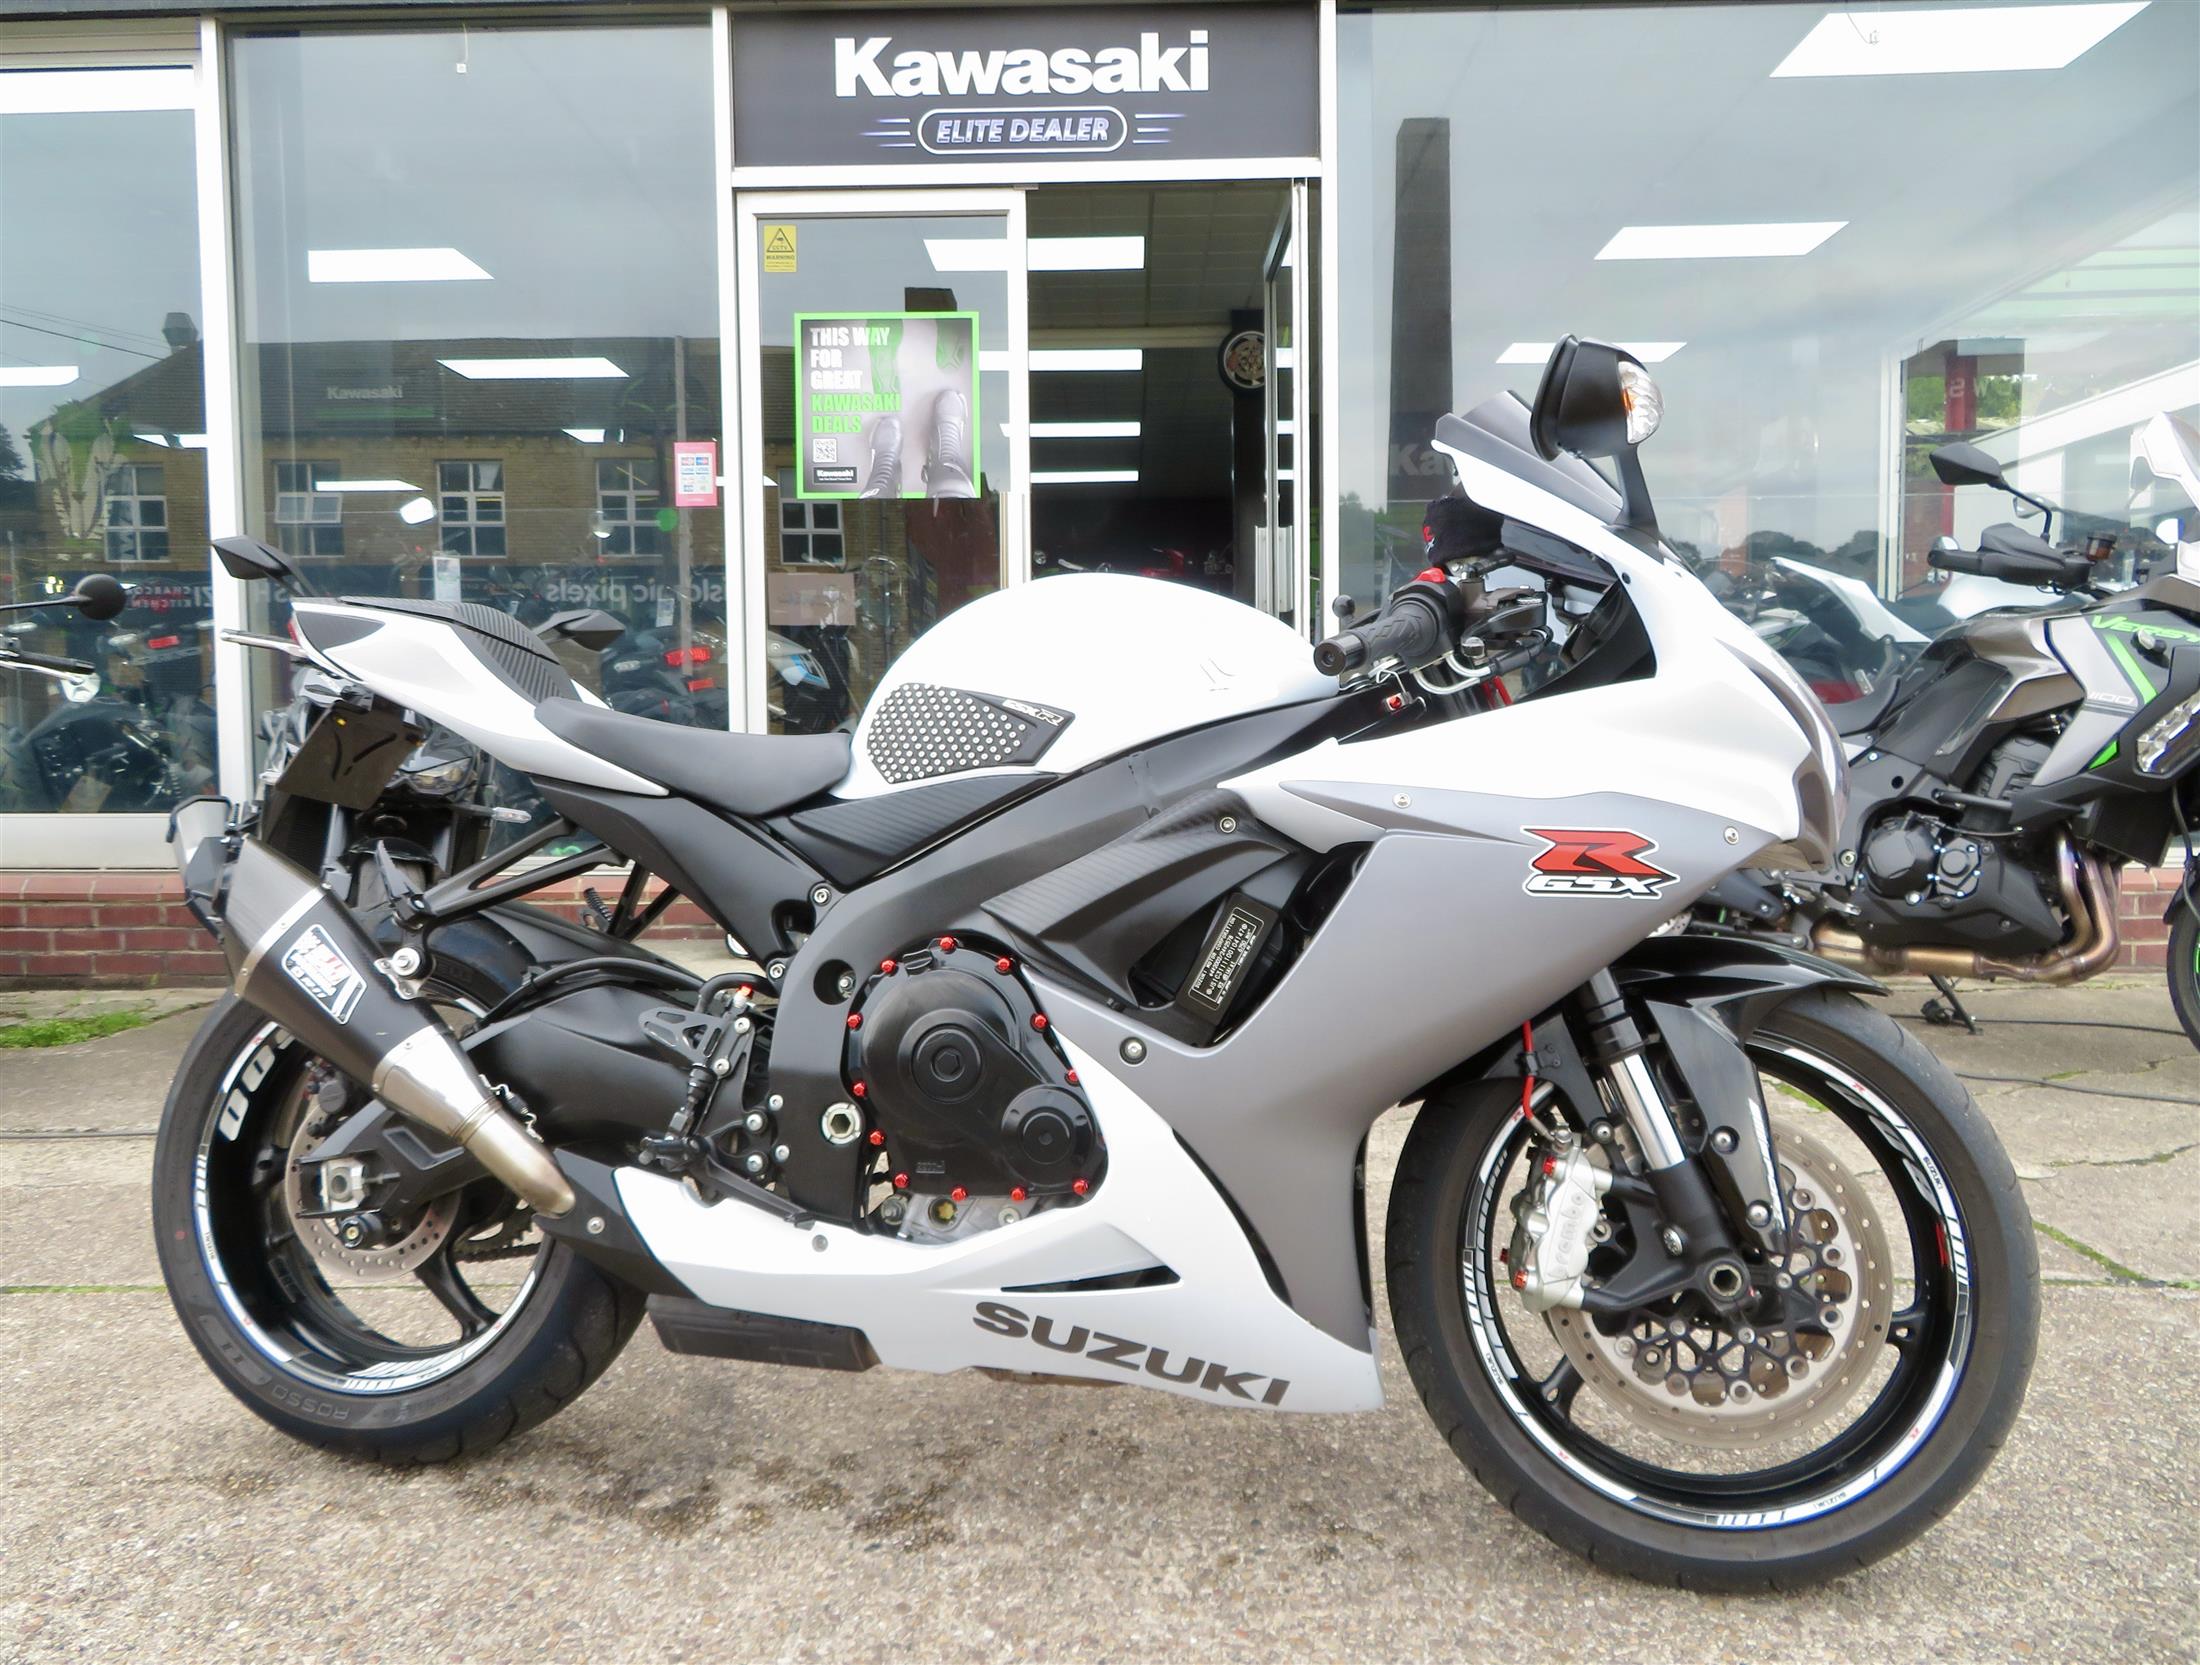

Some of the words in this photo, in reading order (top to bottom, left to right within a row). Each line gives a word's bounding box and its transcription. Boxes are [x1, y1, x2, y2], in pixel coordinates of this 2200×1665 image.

[835, 30, 1209, 97] Kawasaki
[936, 118, 1004, 143] ELITE
[1009, 117, 1110, 142] DEALER
[810, 327, 850, 347] THIS
[852, 327, 890, 346] WAY
[810, 349, 843, 368] FOR
[810, 370, 863, 390] GREAT
[327, 385, 403, 399] Kawasaki
[811, 393, 902, 412] KAWASAKI
[812, 415, 862, 433] DEALS
[1524, 874, 1663, 896] GSX
[1195, 970, 1207, 989] SUZUKI
[1207, 952, 1217, 969] MOTOR
[1216, 917, 1236, 950] CORPORATION
[1546, 1191, 1586, 1280] brembo
[972, 1301, 1291, 1407] SUZUKI
[270, 1384, 351, 1421] ROSSO
